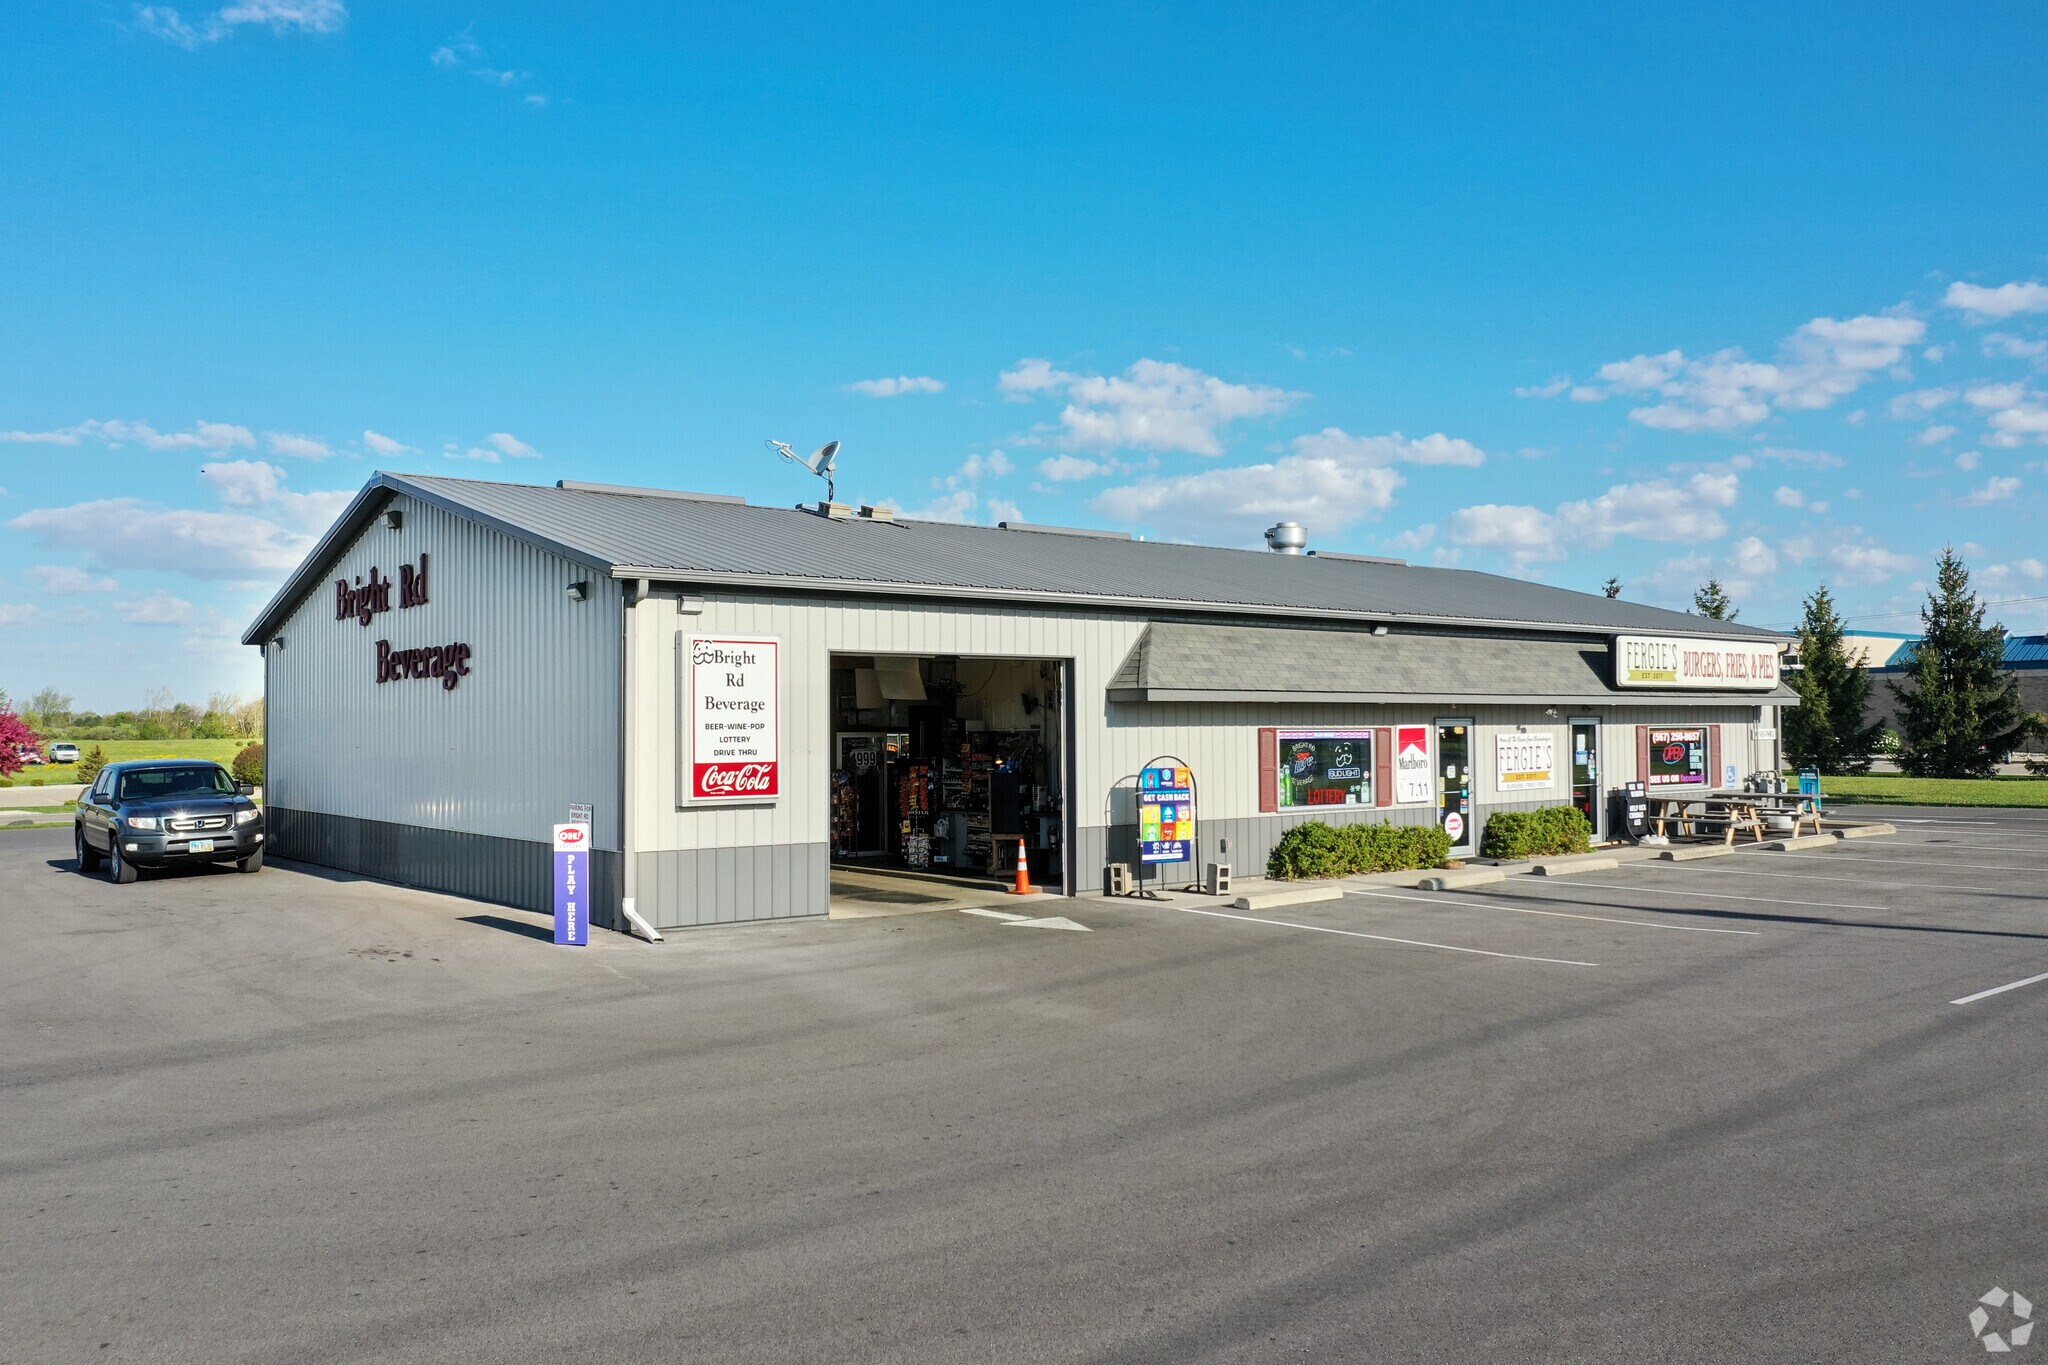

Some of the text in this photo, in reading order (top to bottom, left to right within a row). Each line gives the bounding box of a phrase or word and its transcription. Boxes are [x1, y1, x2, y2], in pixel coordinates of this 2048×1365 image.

[335, 552, 429, 627] Bright Rd
[714, 650, 756, 667] Bright
[1626, 641, 1678, 670] FERGIE'S
[375, 639, 471, 691] Beverage
[1683, 651, 1775, 683] BURGERS, FRIES, & PIES
[726, 673, 745, 688] Rd
[705, 696, 765, 713] Beverage
[1399, 754, 1428, 770] Marlboro
[1499, 745, 1553, 771] FERGIE'S
[701, 764, 773, 793] Coca-Cola
[1342, 769, 1358, 777] LIGHT
[1650, 775, 1662, 784] SEE
[1661, 774, 1670, 783] US
[1670, 774, 1680, 783] ON
[1143, 793, 1190, 802] GET CASH BACK
[1308, 788, 1346, 804] LOTTERY
[1409, 781, 1429, 797] 7.11
[567, 854, 576, 895] PLAY
[567, 902, 576, 941] HERE
